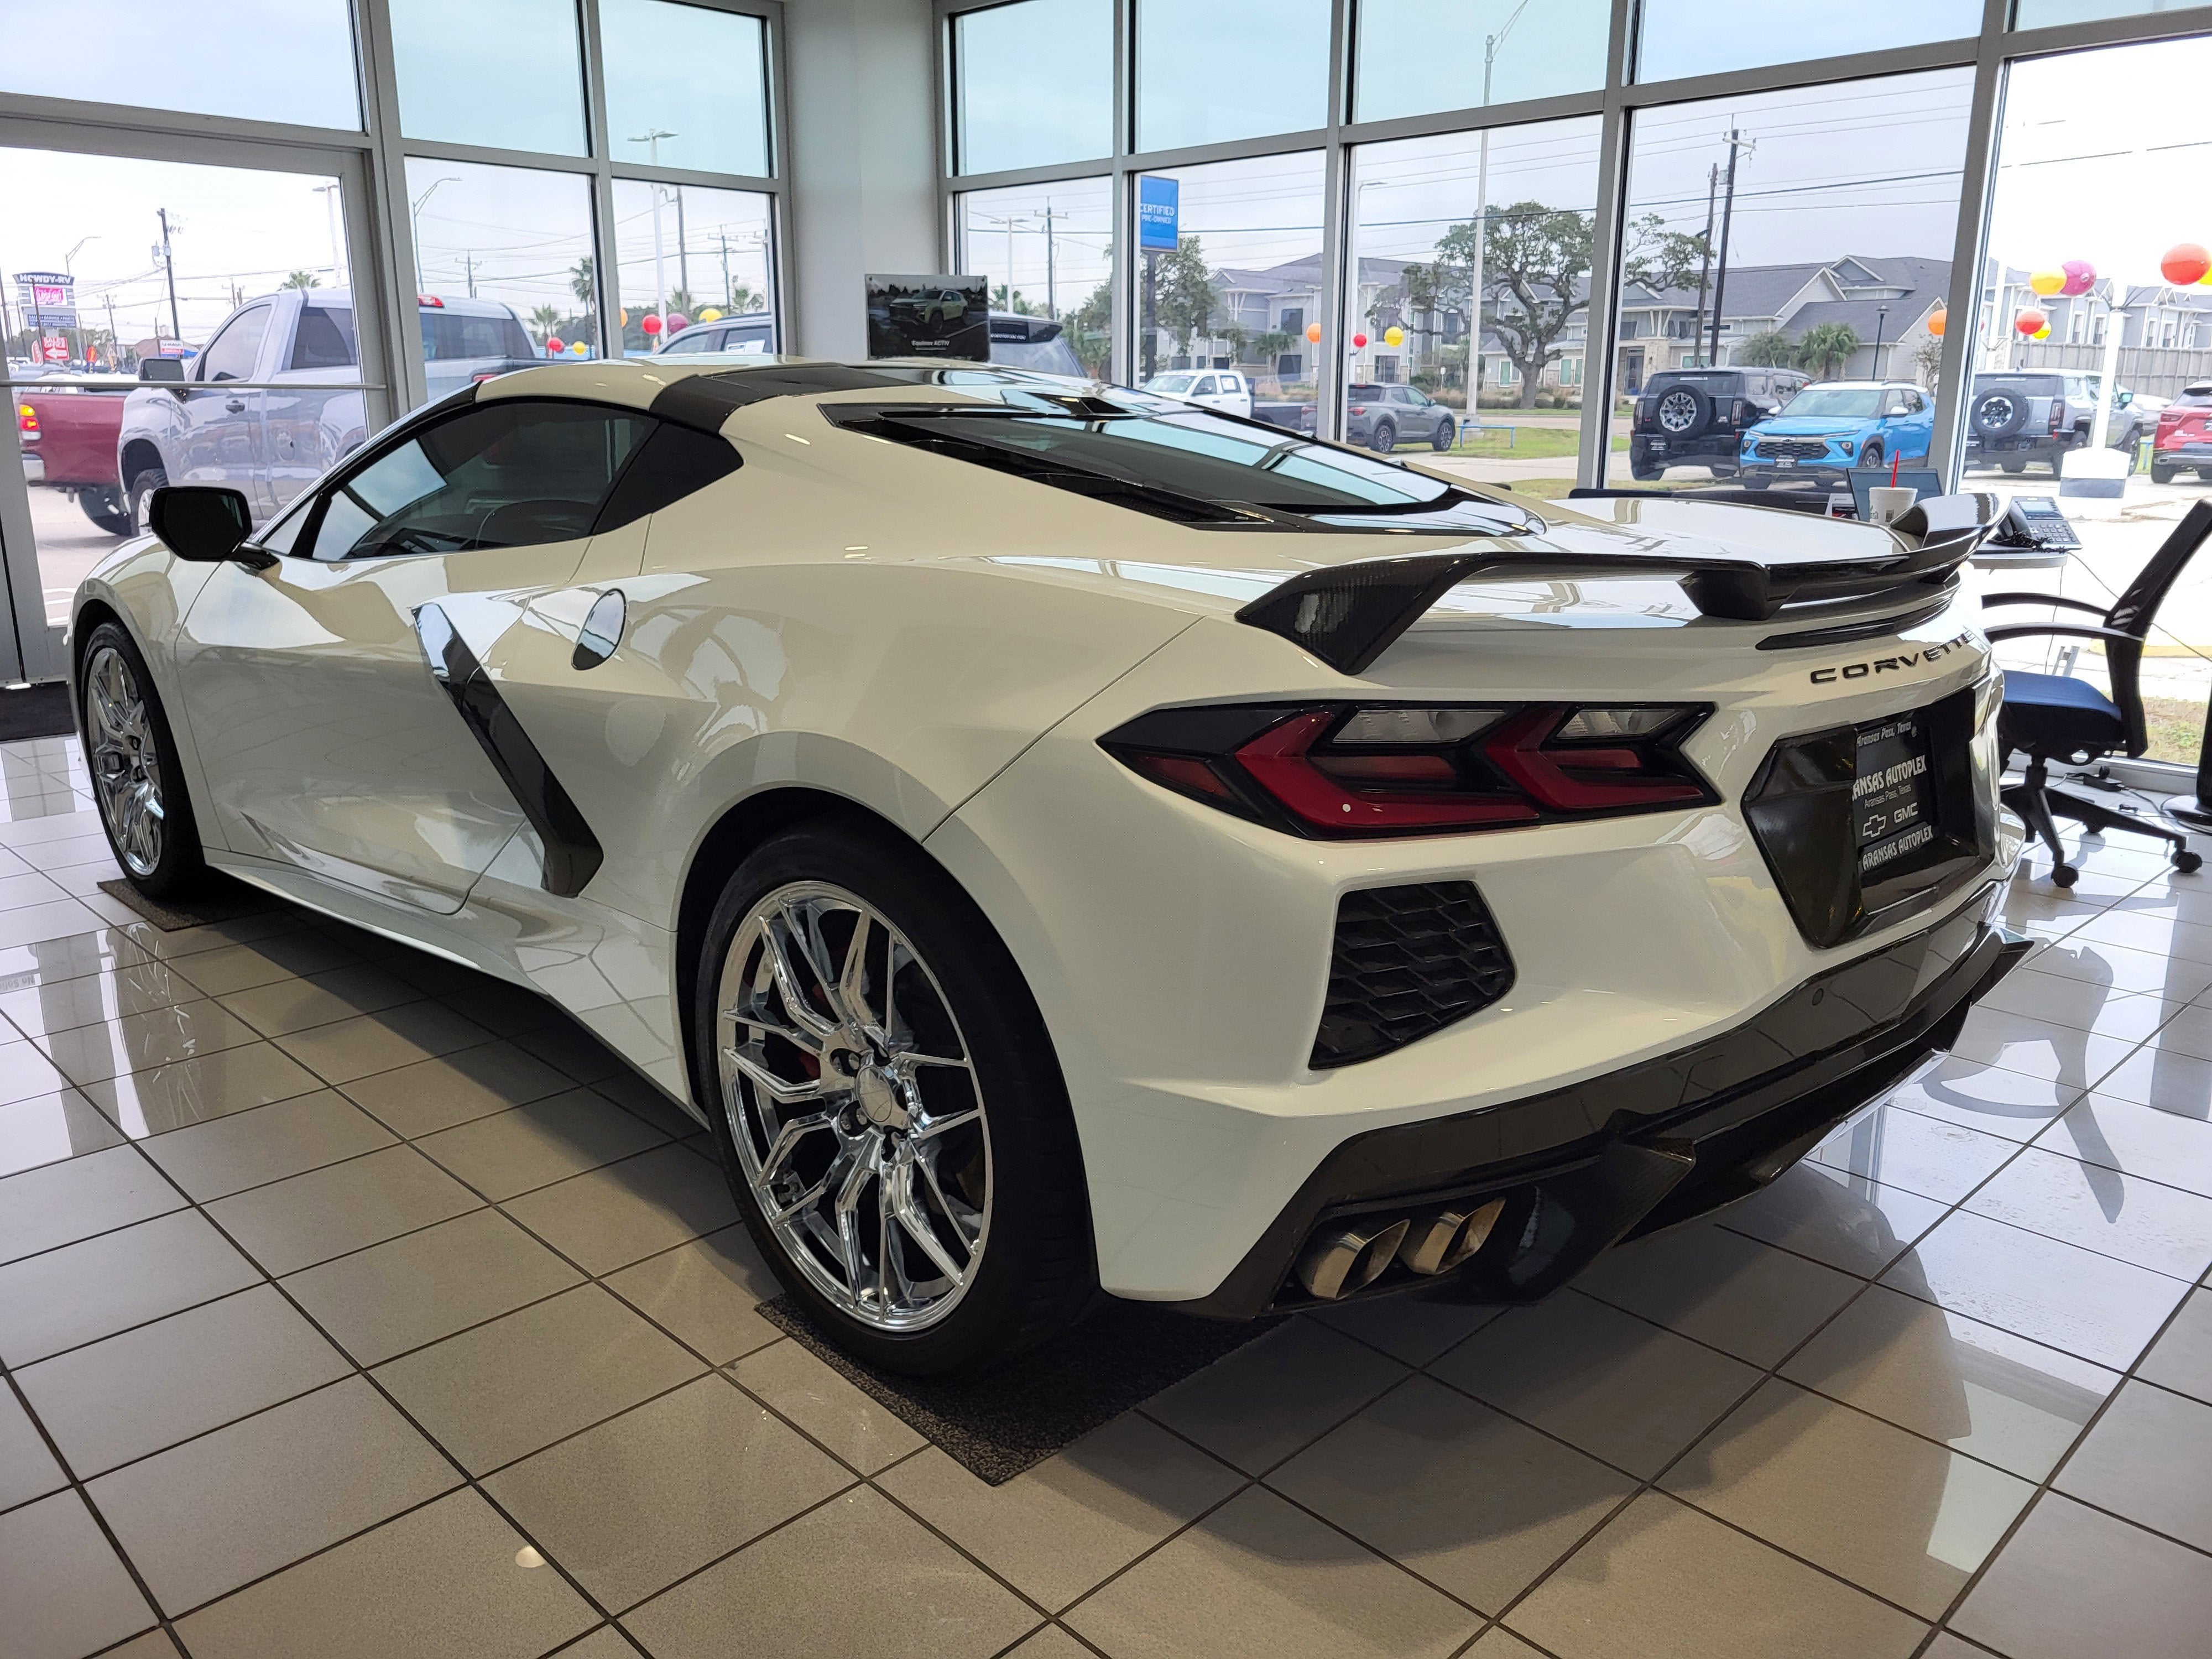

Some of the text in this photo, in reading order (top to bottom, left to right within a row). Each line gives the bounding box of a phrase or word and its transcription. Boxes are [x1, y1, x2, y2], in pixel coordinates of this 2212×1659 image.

[1140, 203, 1175, 216] CERTIFIED
[1141, 214, 1171, 224] PRE-OWNED
[1811, 629, 1976, 684] CORVETTE
[1897, 721, 1912, 734] Texas
[1852, 755, 1927, 801] ANSAS AUTOPLEX
[1864, 795, 1885, 809] Aransas
[1898, 784, 1912, 795] Texas
[1893, 802, 1919, 823] GMC
[1862, 825, 1934, 872] ARANSAS AUTOPLEX
